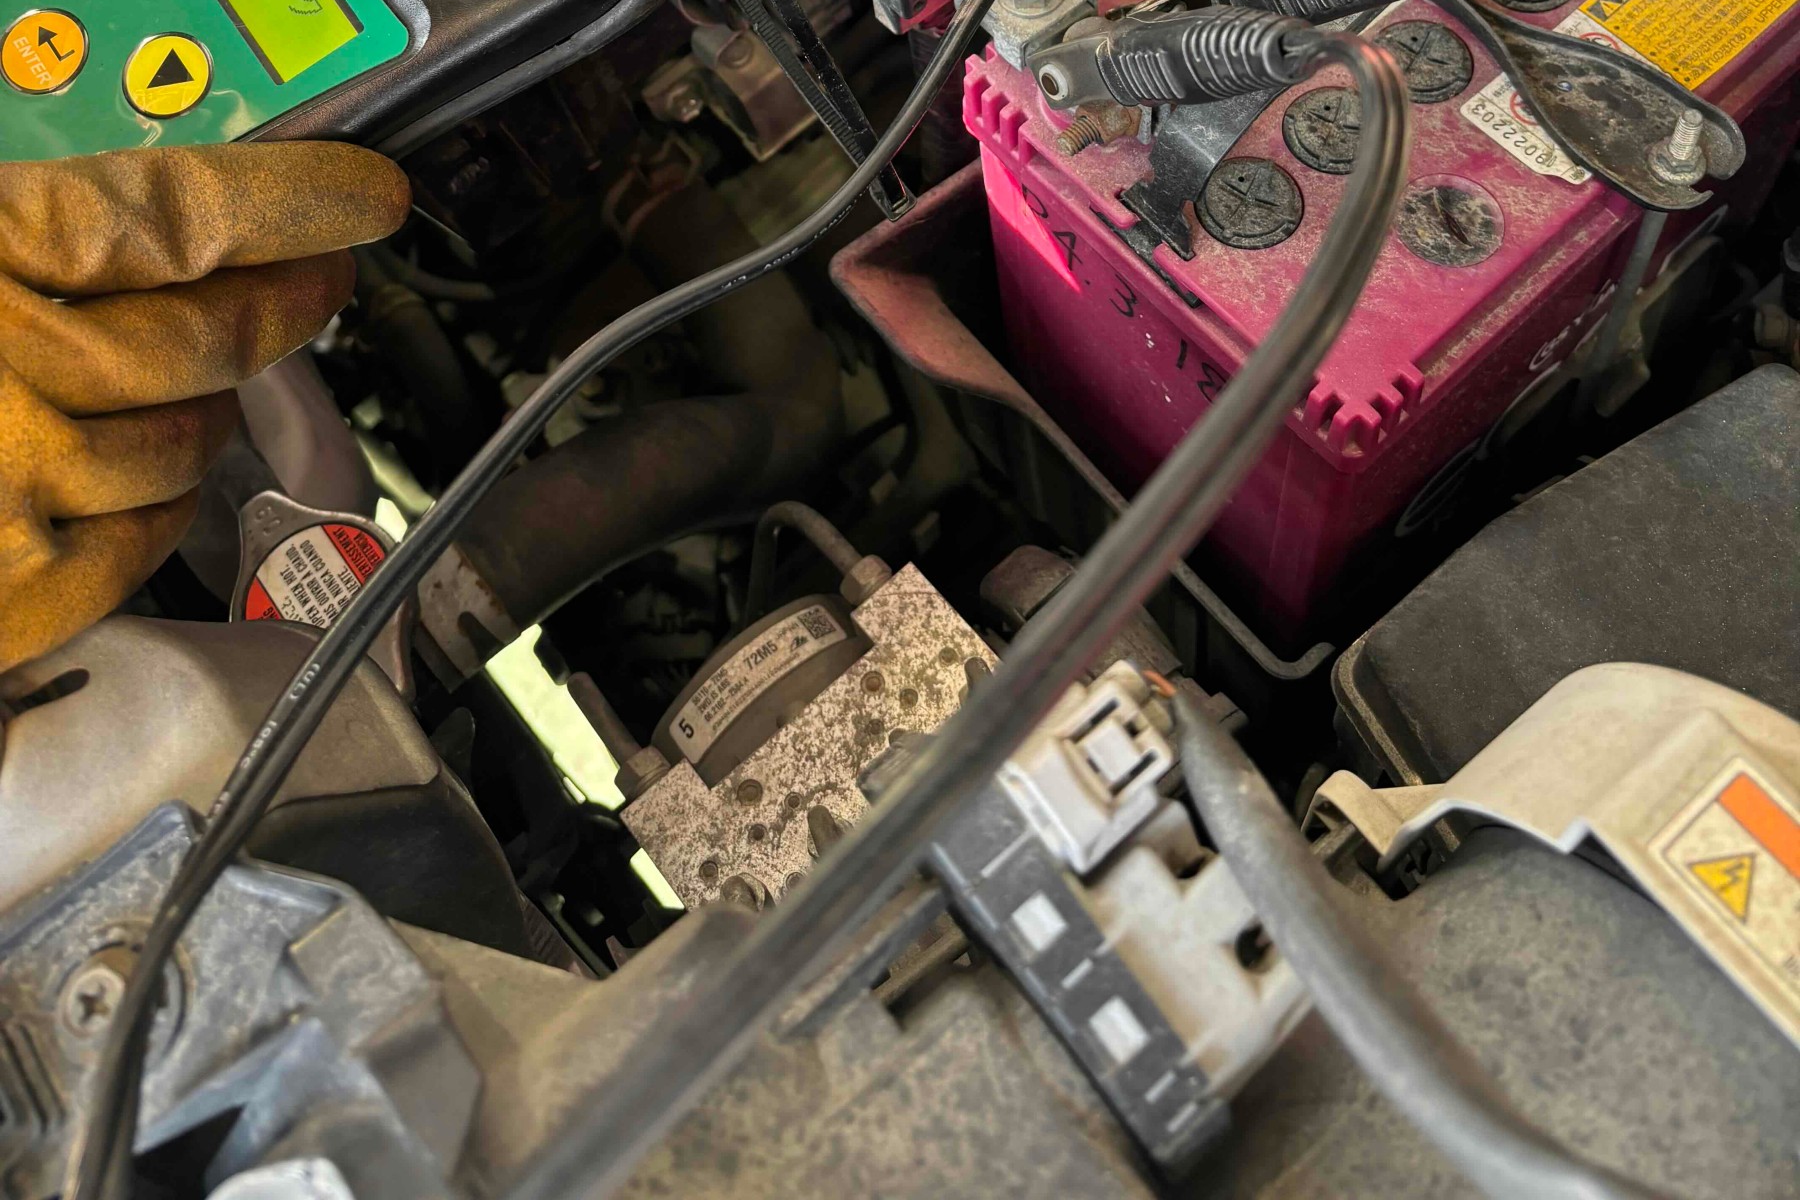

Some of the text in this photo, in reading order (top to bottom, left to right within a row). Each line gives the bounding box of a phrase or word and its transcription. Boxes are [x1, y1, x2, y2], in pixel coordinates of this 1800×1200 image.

[12, 36, 53, 86] ENTER
[300, 540, 342, 598] NUNCA CUANDO
[301, 571, 312, 581] A
[338, 565, 361, 597] LIENTE.
[280, 564, 326, 627] OPEN WHEN HOT.
[306, 577, 330, 606] OUVRIR
[743, 641, 778, 670] 72M5
[718, 679, 731, 694] ABS
[239, 661, 321, 770] (UL) 105°C
[678, 718, 694, 739] 5
